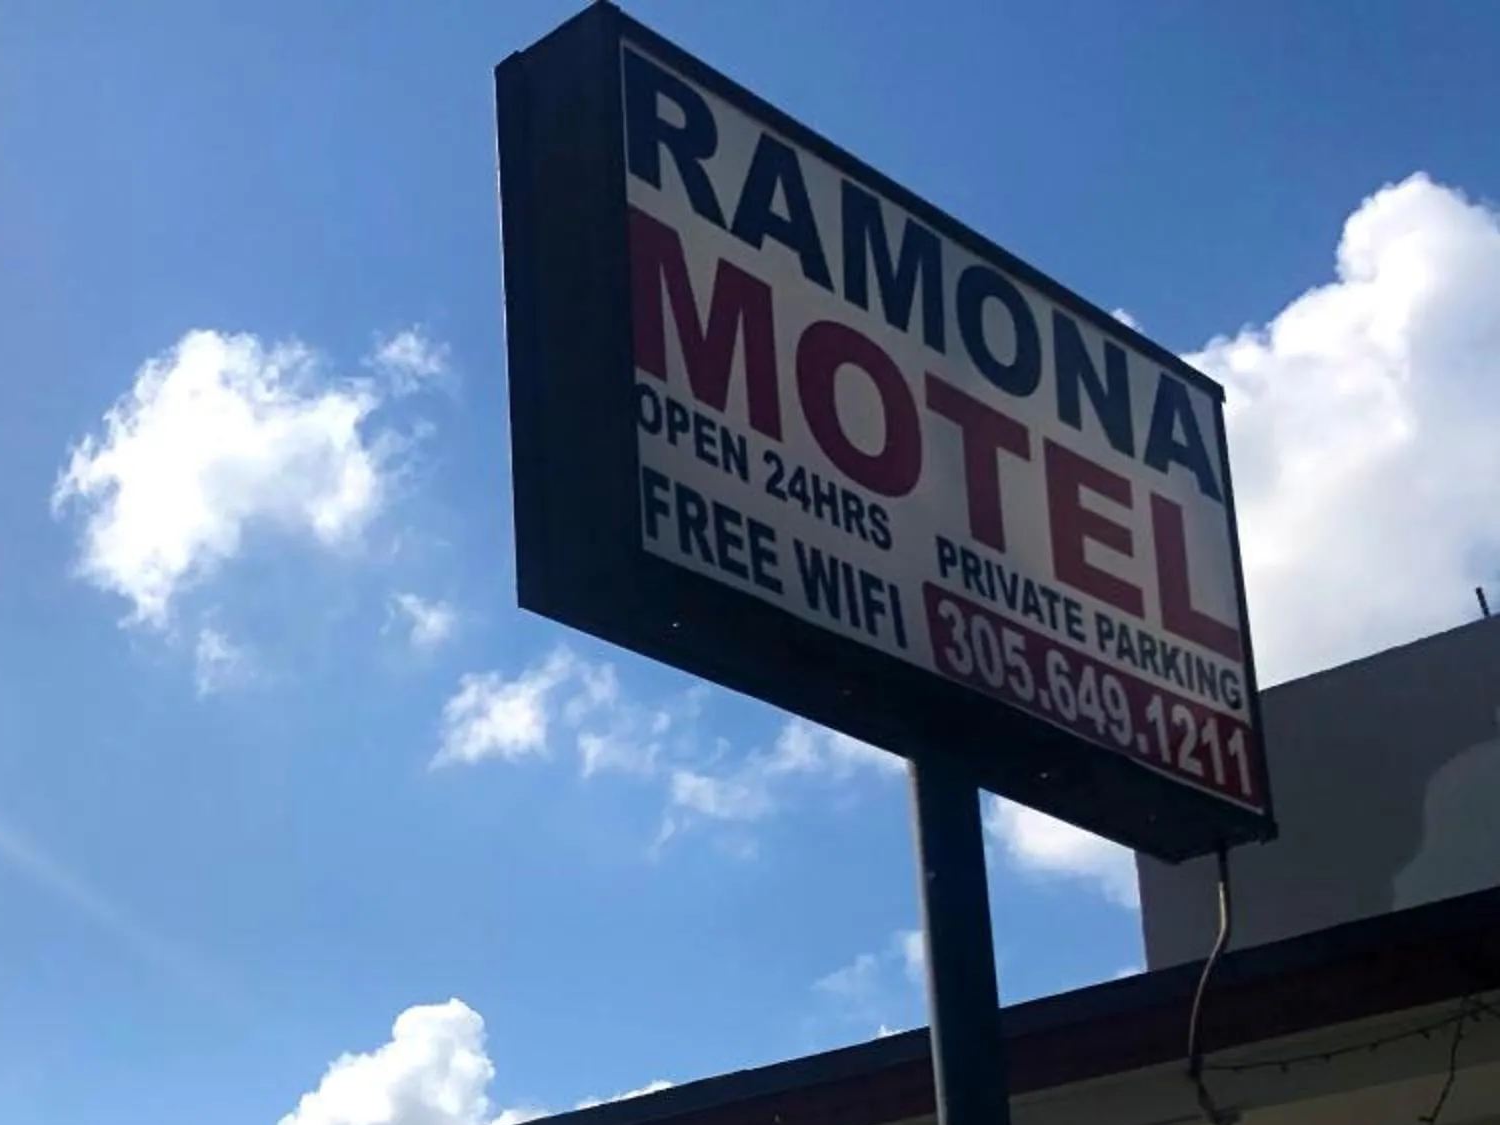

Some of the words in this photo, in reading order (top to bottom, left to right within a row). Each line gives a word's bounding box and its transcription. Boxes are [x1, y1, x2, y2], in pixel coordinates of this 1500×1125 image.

[624, 47, 1223, 501] RAMONA
[629, 207, 1243, 663] MOTEL
[635, 383, 750, 483] OPEN
[763, 449, 893, 551] 24HRS
[642, 465, 785, 596] FREE
[793, 537, 908, 650] WIFI
[935, 534, 1087, 645] PRIVATE
[1094, 610, 1244, 712] PARKING
[937, 599, 1252, 797] 305.649.1211
